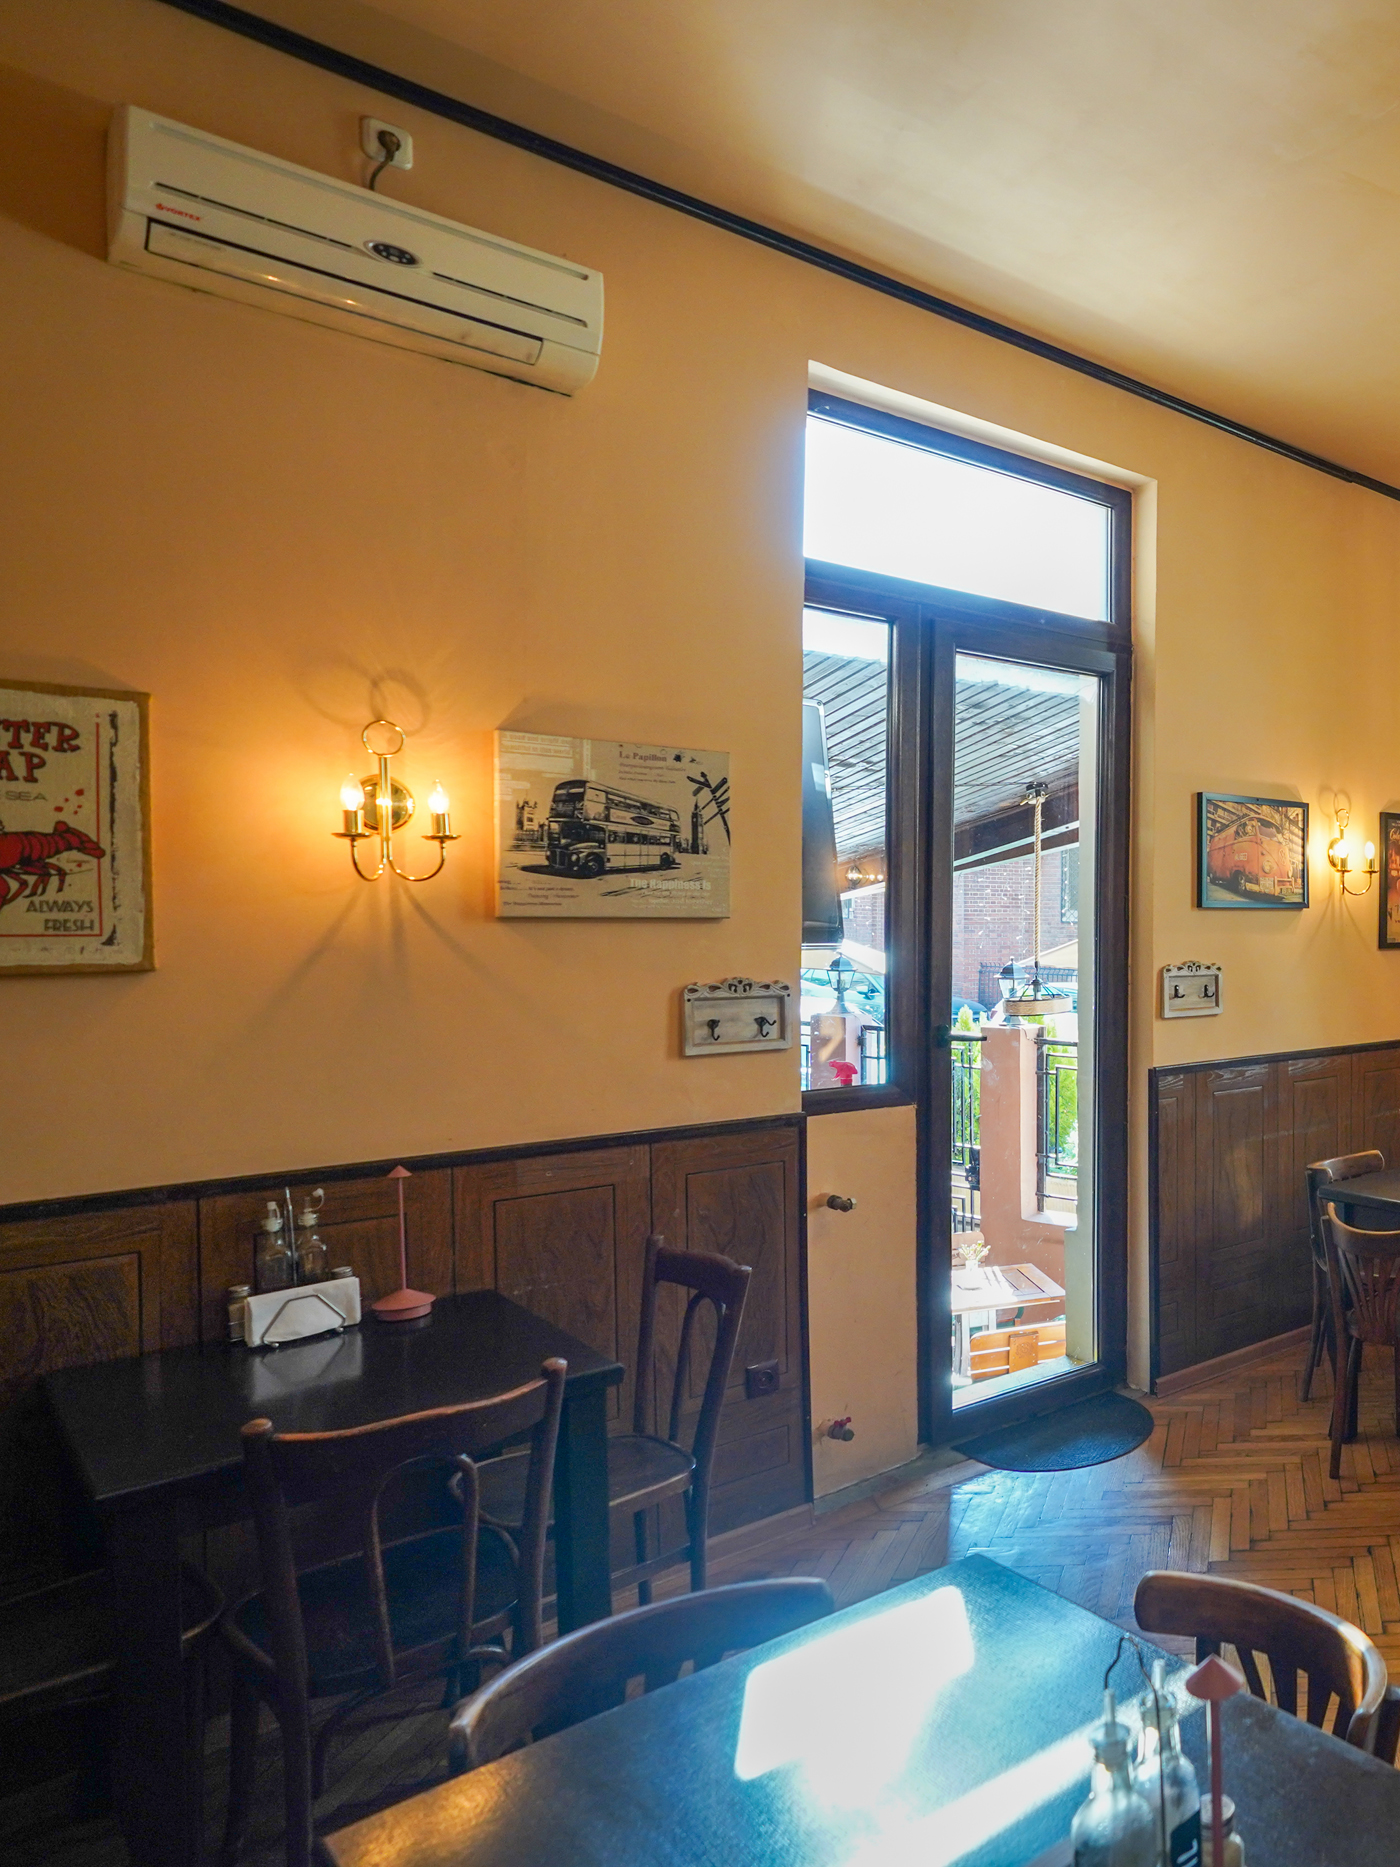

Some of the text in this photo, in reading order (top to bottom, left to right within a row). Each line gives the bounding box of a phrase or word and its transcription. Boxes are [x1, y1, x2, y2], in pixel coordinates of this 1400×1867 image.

[163, 206, 201, 221] VORTEX
[633, 752, 667, 762] Papillon
[5, 791, 48, 802] SEA
[26, 900, 94, 913] ALWAYS
[44, 919, 95, 932] FRESH
